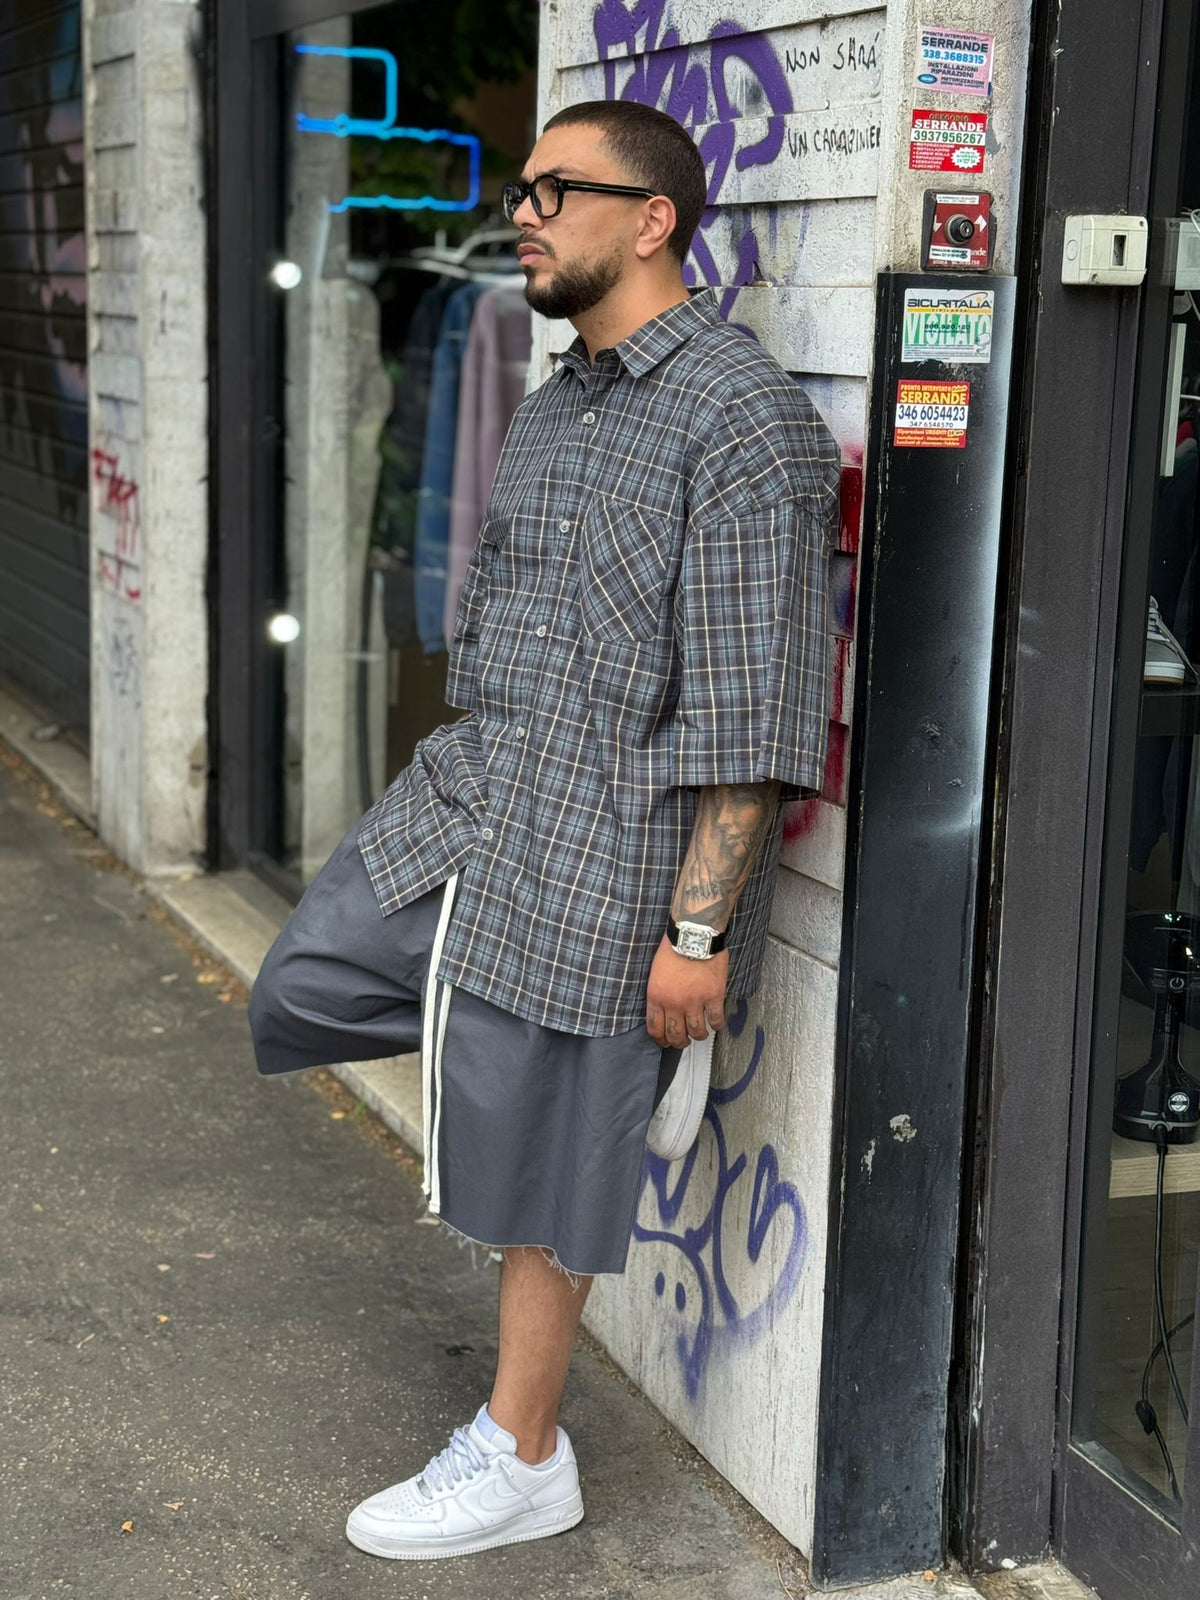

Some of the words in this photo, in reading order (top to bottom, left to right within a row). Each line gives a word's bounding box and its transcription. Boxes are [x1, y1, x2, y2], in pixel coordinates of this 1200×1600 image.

[921, 36, 988, 53] SERRANDE
[786, 46, 820, 73] NON
[923, 49, 984, 64] 338.3688315
[928, 62, 978, 72] INSTALLAZIONI
[931, 68, 974, 78] RIPARAZIONI
[941, 76, 985, 85] MOTORIZZAZIONI
[914, 119, 984, 132] SERRANDE
[788, 128, 808, 159] UN
[914, 130, 983, 144] 3937956267
[907, 298, 991, 308] SICURITALIA
[906, 314, 991, 346] VIGILATO
[900, 391, 966, 404] SERRANDE
[898, 405, 917, 420] 346
[920, 406, 965, 421] 6054423
